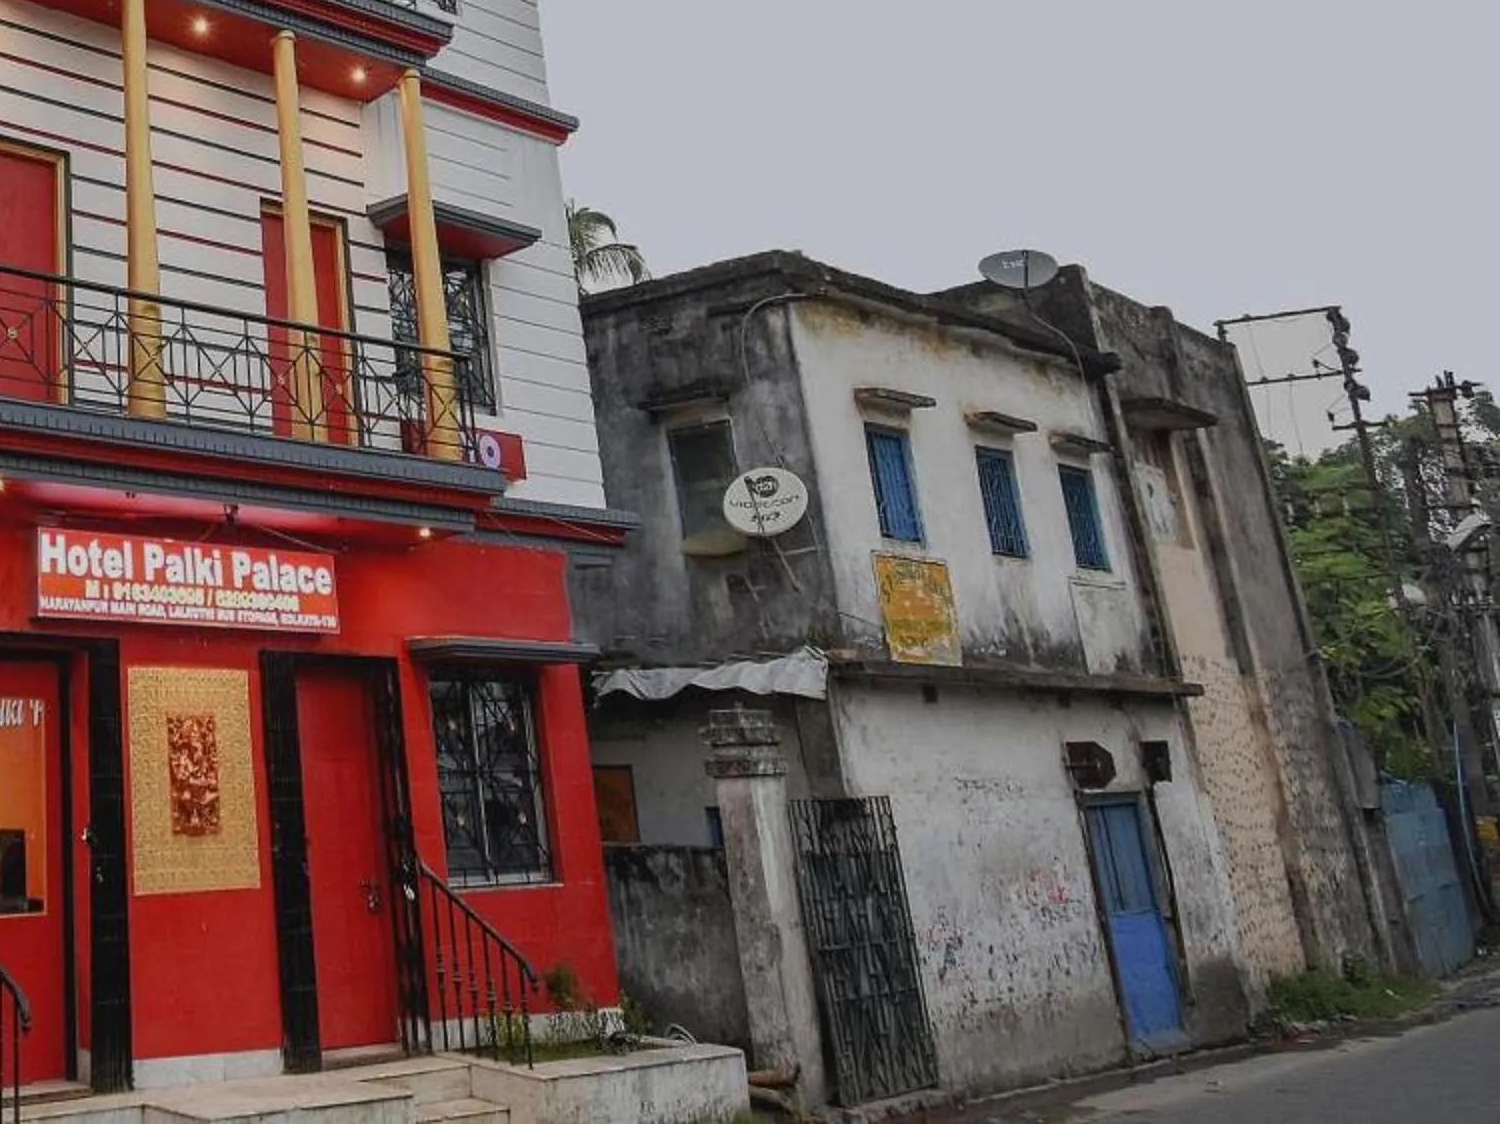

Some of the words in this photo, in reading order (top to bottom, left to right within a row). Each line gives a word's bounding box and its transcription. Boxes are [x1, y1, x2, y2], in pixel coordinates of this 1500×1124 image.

[40, 534, 133, 579] Hotel
[144, 543, 223, 587] Palki
[231, 551, 333, 595] Palace
